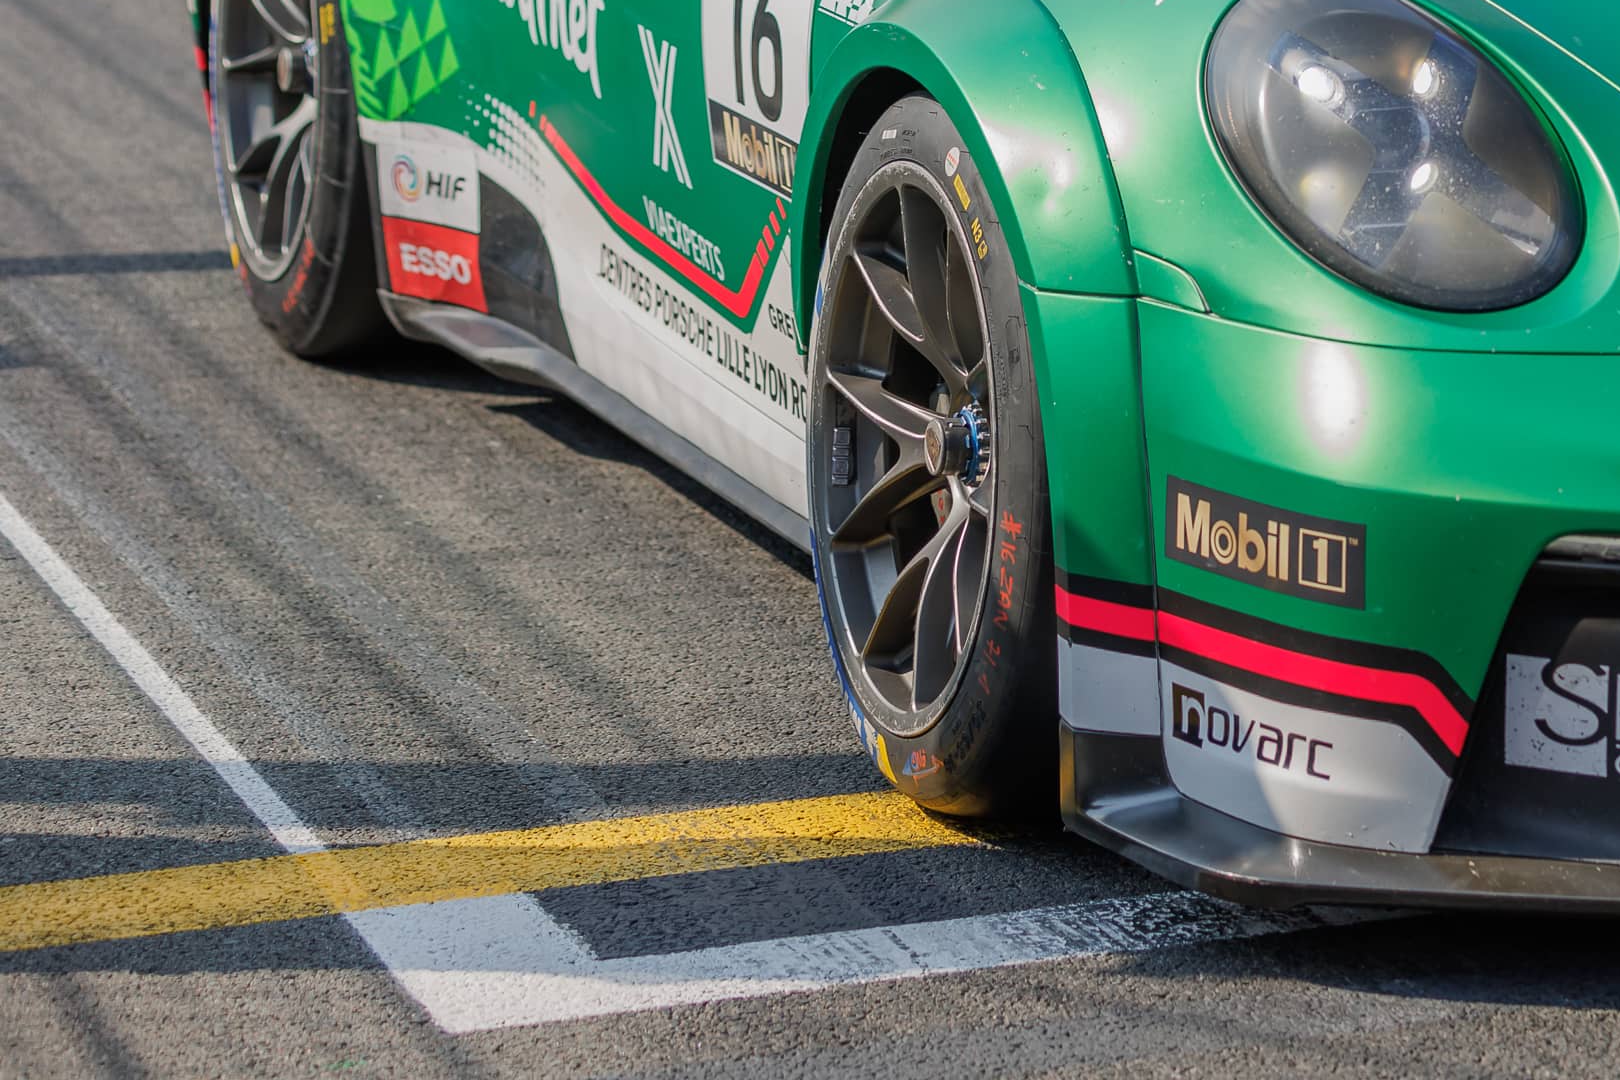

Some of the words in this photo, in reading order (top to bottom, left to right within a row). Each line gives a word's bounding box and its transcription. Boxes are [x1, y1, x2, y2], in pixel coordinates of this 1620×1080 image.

[425, 169, 467, 201] HIF
[722, 110, 777, 185] Mobil
[399, 243, 472, 285] ESSO
[643, 195, 726, 281] VIAEXPERTS
[600, 242, 653, 313] CENTRES
[654, 280, 714, 357] PORSCHE
[716, 325, 750, 384] LILLE
[752, 351, 789, 410] LYON
[1174, 492, 1291, 582] Mobil
[1176, 692, 1334, 781] novarc
